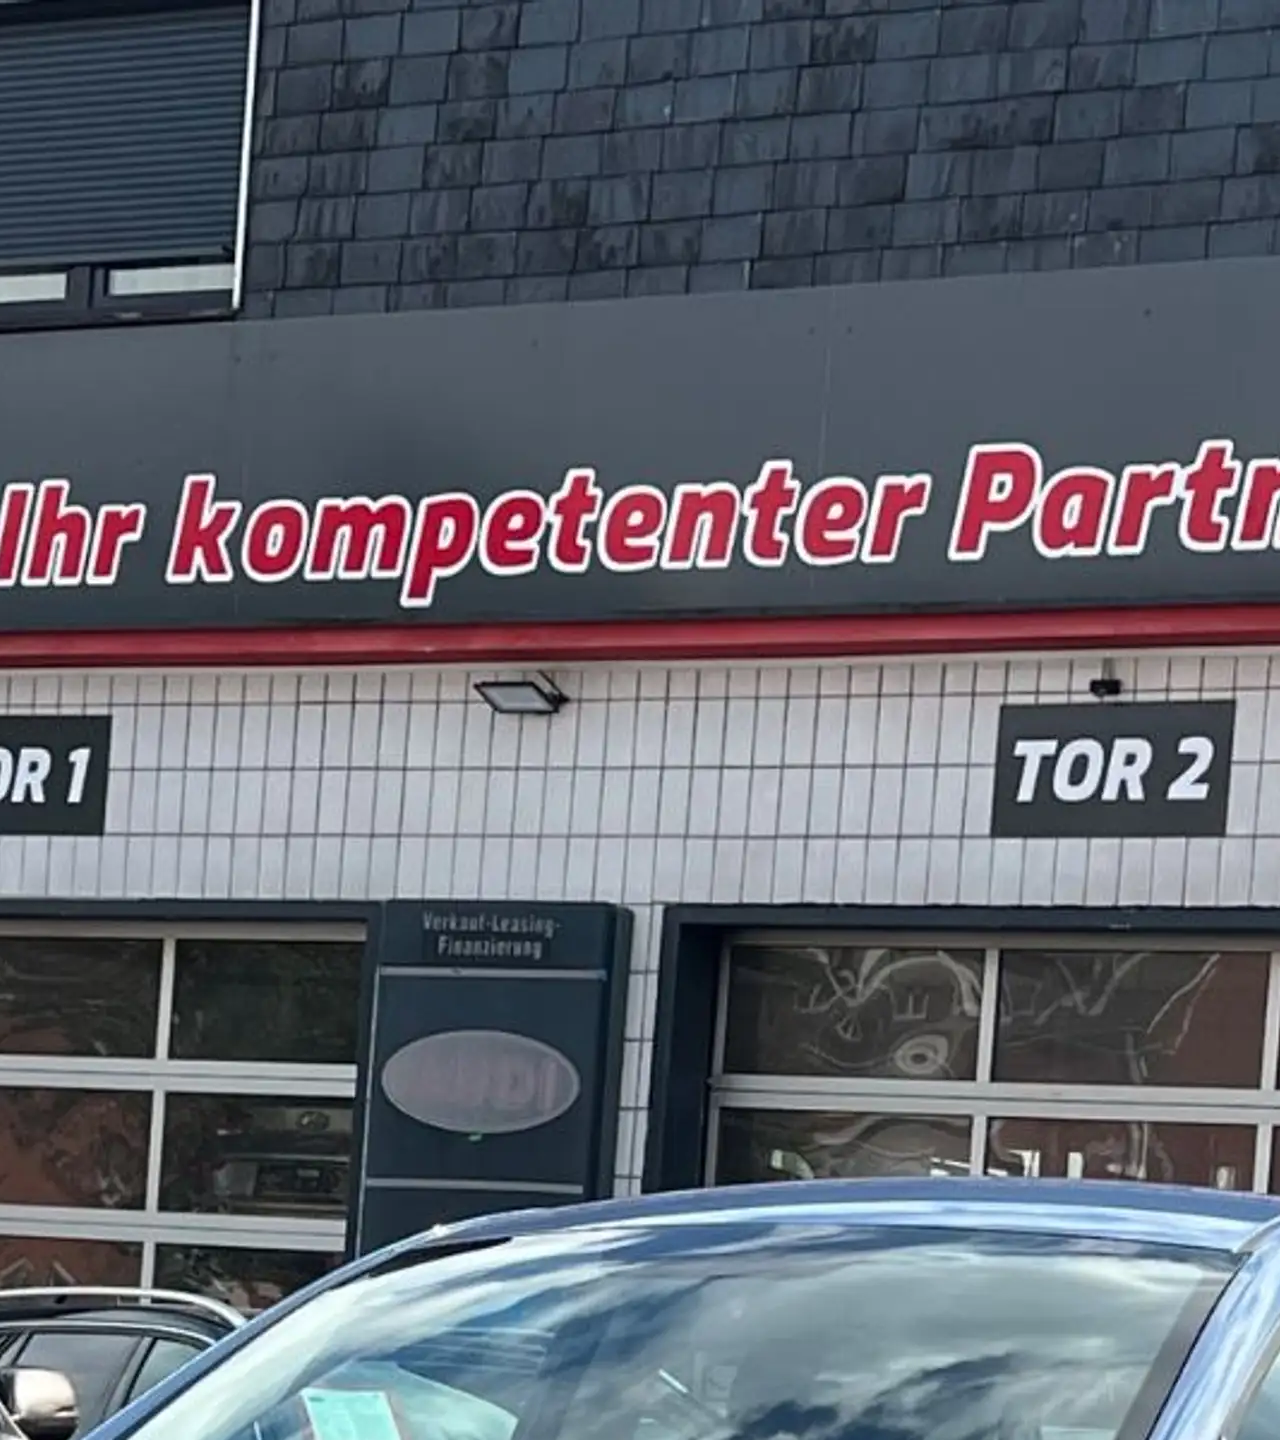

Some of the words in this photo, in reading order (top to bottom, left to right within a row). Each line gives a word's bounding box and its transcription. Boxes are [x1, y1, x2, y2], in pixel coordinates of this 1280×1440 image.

[165, 460, 932, 607] kompetenter
[66, 747, 91, 803] 1
[1012, 737, 1154, 803] TOR
[1167, 736, 1215, 801] 2
[437, 935, 543, 960] Finanzierung
